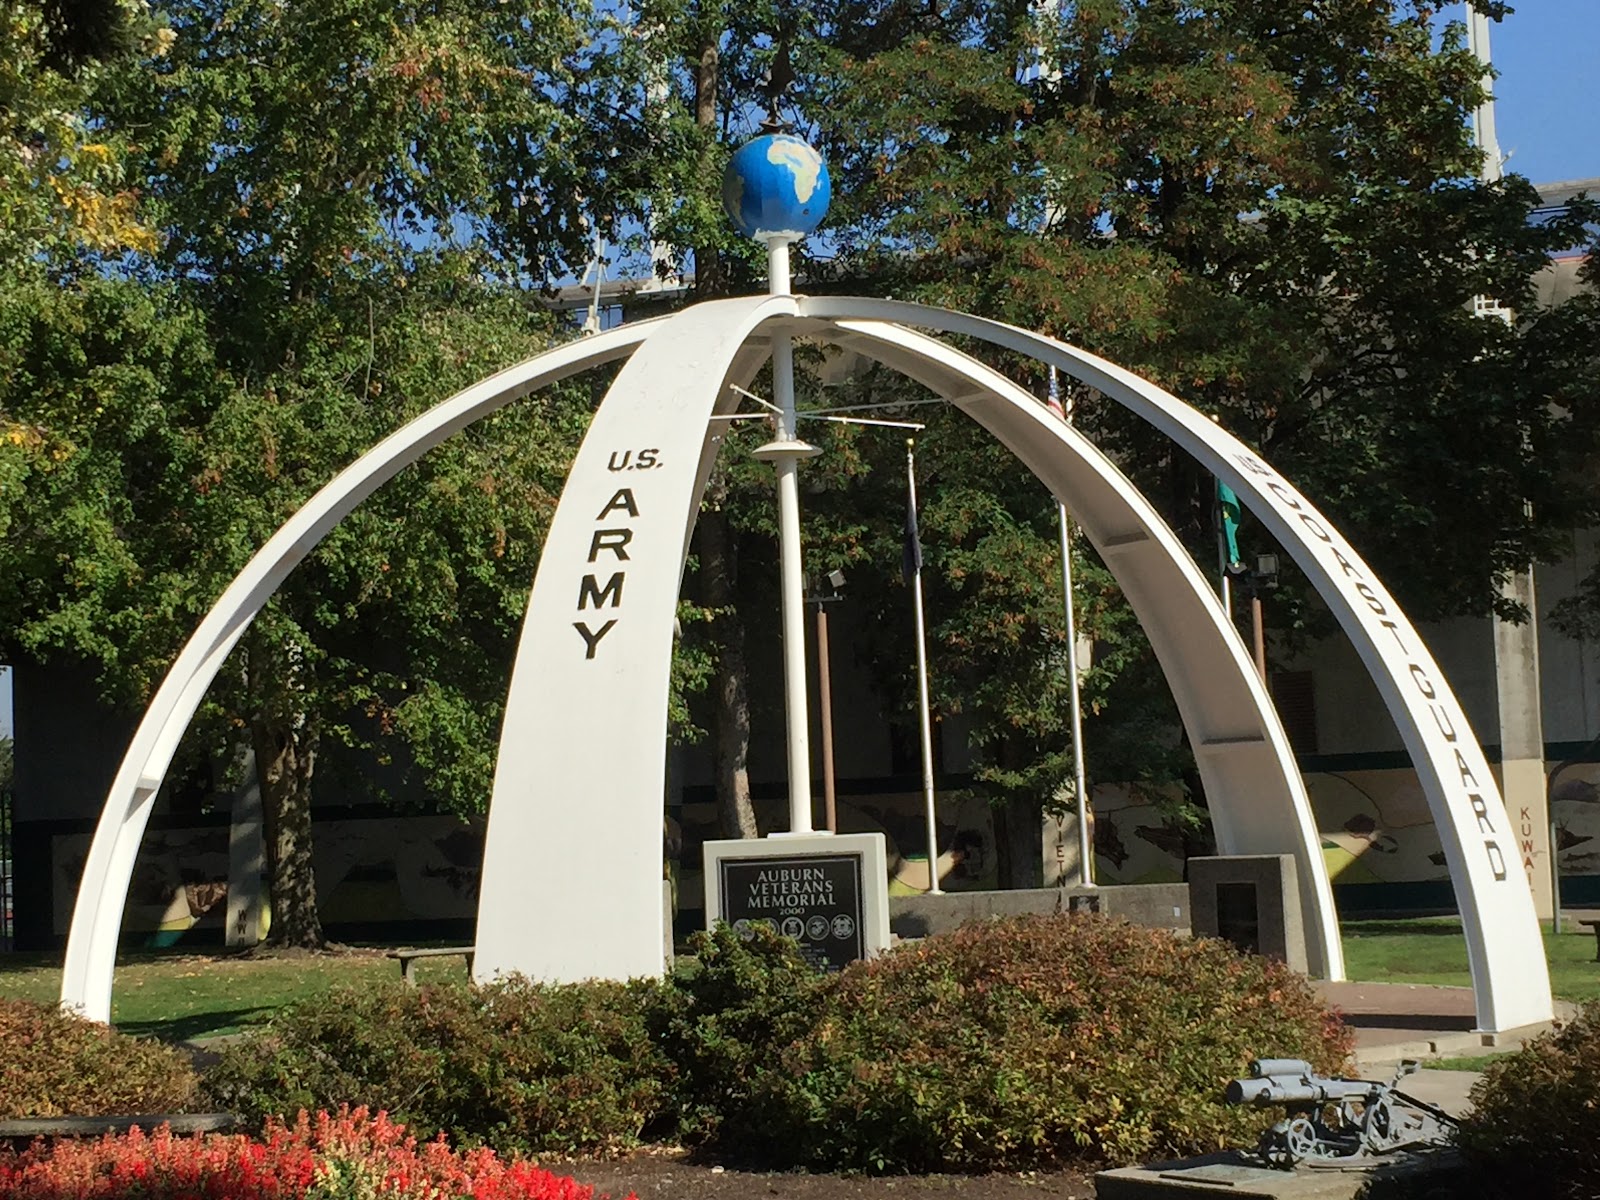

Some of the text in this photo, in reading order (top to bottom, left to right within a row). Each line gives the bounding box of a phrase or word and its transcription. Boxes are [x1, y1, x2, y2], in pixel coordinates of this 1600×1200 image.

[608, 449, 663, 472] U.S.
[572, 488, 640, 660] ARMY
[1265, 481, 1409, 656] COAST
[1409, 663, 1507, 882] GUARD
[757, 868, 825, 883] AUBURN
[749, 880, 834, 896] VETERANS
[747, 893, 837, 909] MEMORIAL
[779, 907, 806, 916] 2000
